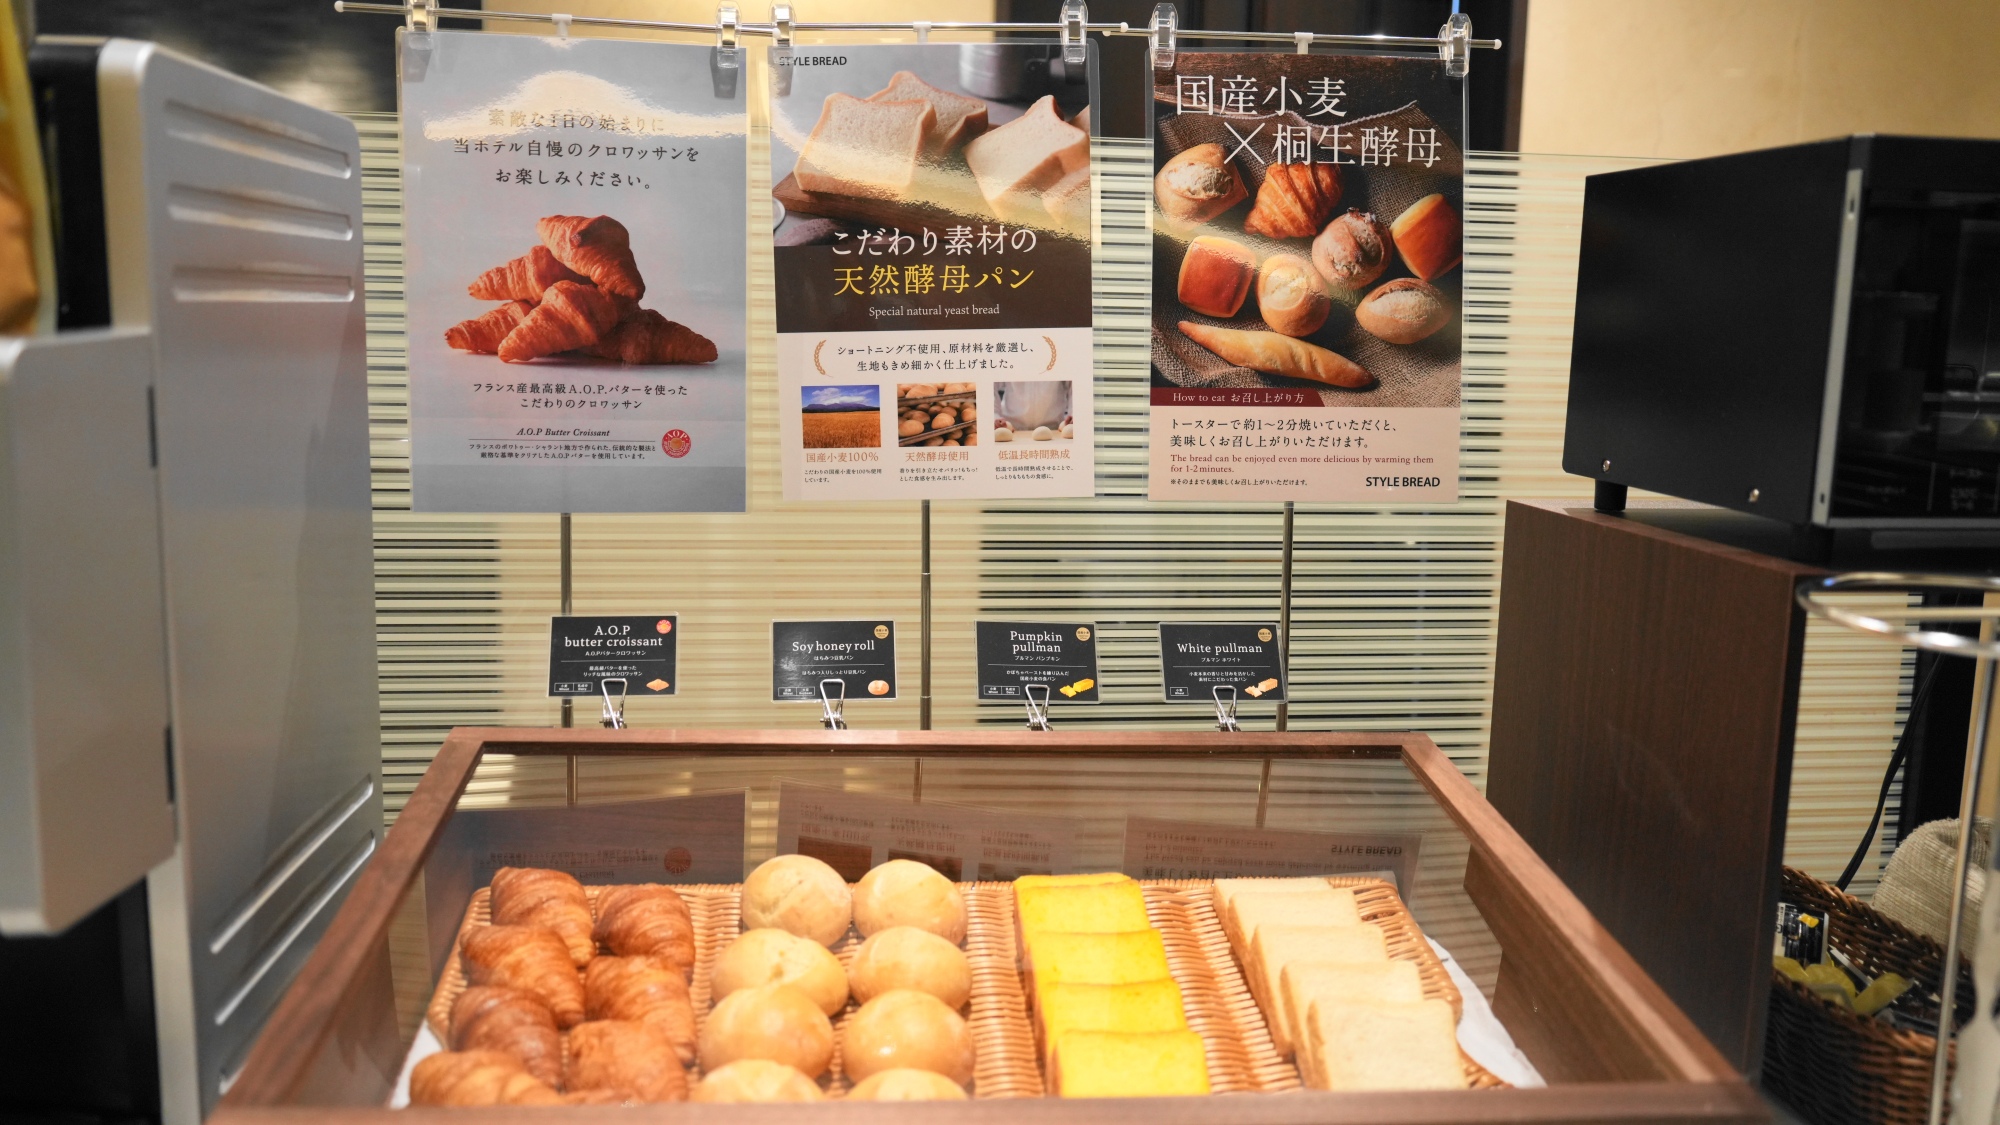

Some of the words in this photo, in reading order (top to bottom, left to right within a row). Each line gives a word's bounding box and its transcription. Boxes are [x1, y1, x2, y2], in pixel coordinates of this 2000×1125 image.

[779, 56, 810, 66] STYLE
[812, 56, 848, 66] BREAD
[1176, 74, 1347, 117] 国産小麦
[489, 108, 664, 131] 素敵な1日の始まりに
[454, 138, 699, 162] 当ホテル自慢のクロワッサンを
[496, 168, 651, 189] お楽しみください。
[831, 224, 1037, 257] こだわり素材の
[833, 263, 1035, 296] 天然酵母パン
[869, 305, 904, 318] Special
[906, 305, 942, 317] natural
[945, 306, 970, 319] yeast
[972, 304, 1000, 316] bread
[837, 341, 1035, 356] ショートニング不使用、原材料を厳選し、
[856, 358, 1015, 372] 生地もきめ細かく仕上げました。
[473, 382, 688, 396] フランス産最高級A.O.P.バターを使った
[520, 398, 642, 410] こだわりのクロワッサン
[1172, 392, 1197, 403] How
[1199, 393, 1209, 403] to
[1211, 393, 1226, 403] eat
[1230, 392, 1305, 404] お召し上がり方
[516, 428, 543, 436] A.O.P
[545, 428, 570, 437] Butter
[572, 428, 610, 438] Croissant
[1170, 435, 1370, 449] 美味しくお召し上がりいただけます。
[806, 451, 879, 463] 国産小麦100%
[905, 451, 969, 463] 天然酵母使用
[998, 449, 1071, 461] 低温長時間熟成
[1171, 454, 1187, 463] The
[1189, 454, 1213, 463] bread
[1232, 454, 1243, 464] be
[1245, 455, 1276, 466] enjoyed
[1323, 454, 1360, 464] delicious
[1362, 454, 1373, 467] by
[1375, 455, 1411, 467] warming
[1413, 455, 1435, 464] them
[1171, 464, 1183, 473] for
[1185, 465, 1199, 473] 1-2
[1200, 465, 1235, 474] minutes.
[1366, 476, 1400, 487] STYLE
[1402, 477, 1441, 488] BREAD
[594, 625, 631, 636] A.O.P
[1010, 630, 1063, 643] Pumpkin
[564, 636, 603, 647] butter
[606, 637, 663, 647] croissant
[792, 641, 814, 653] Soy
[816, 640, 853, 653] honey
[854, 640, 875, 651] roll
[1012, 642, 1062, 654] pullman
[1177, 643, 1212, 653] White
[1215, 642, 1263, 655] pullman
